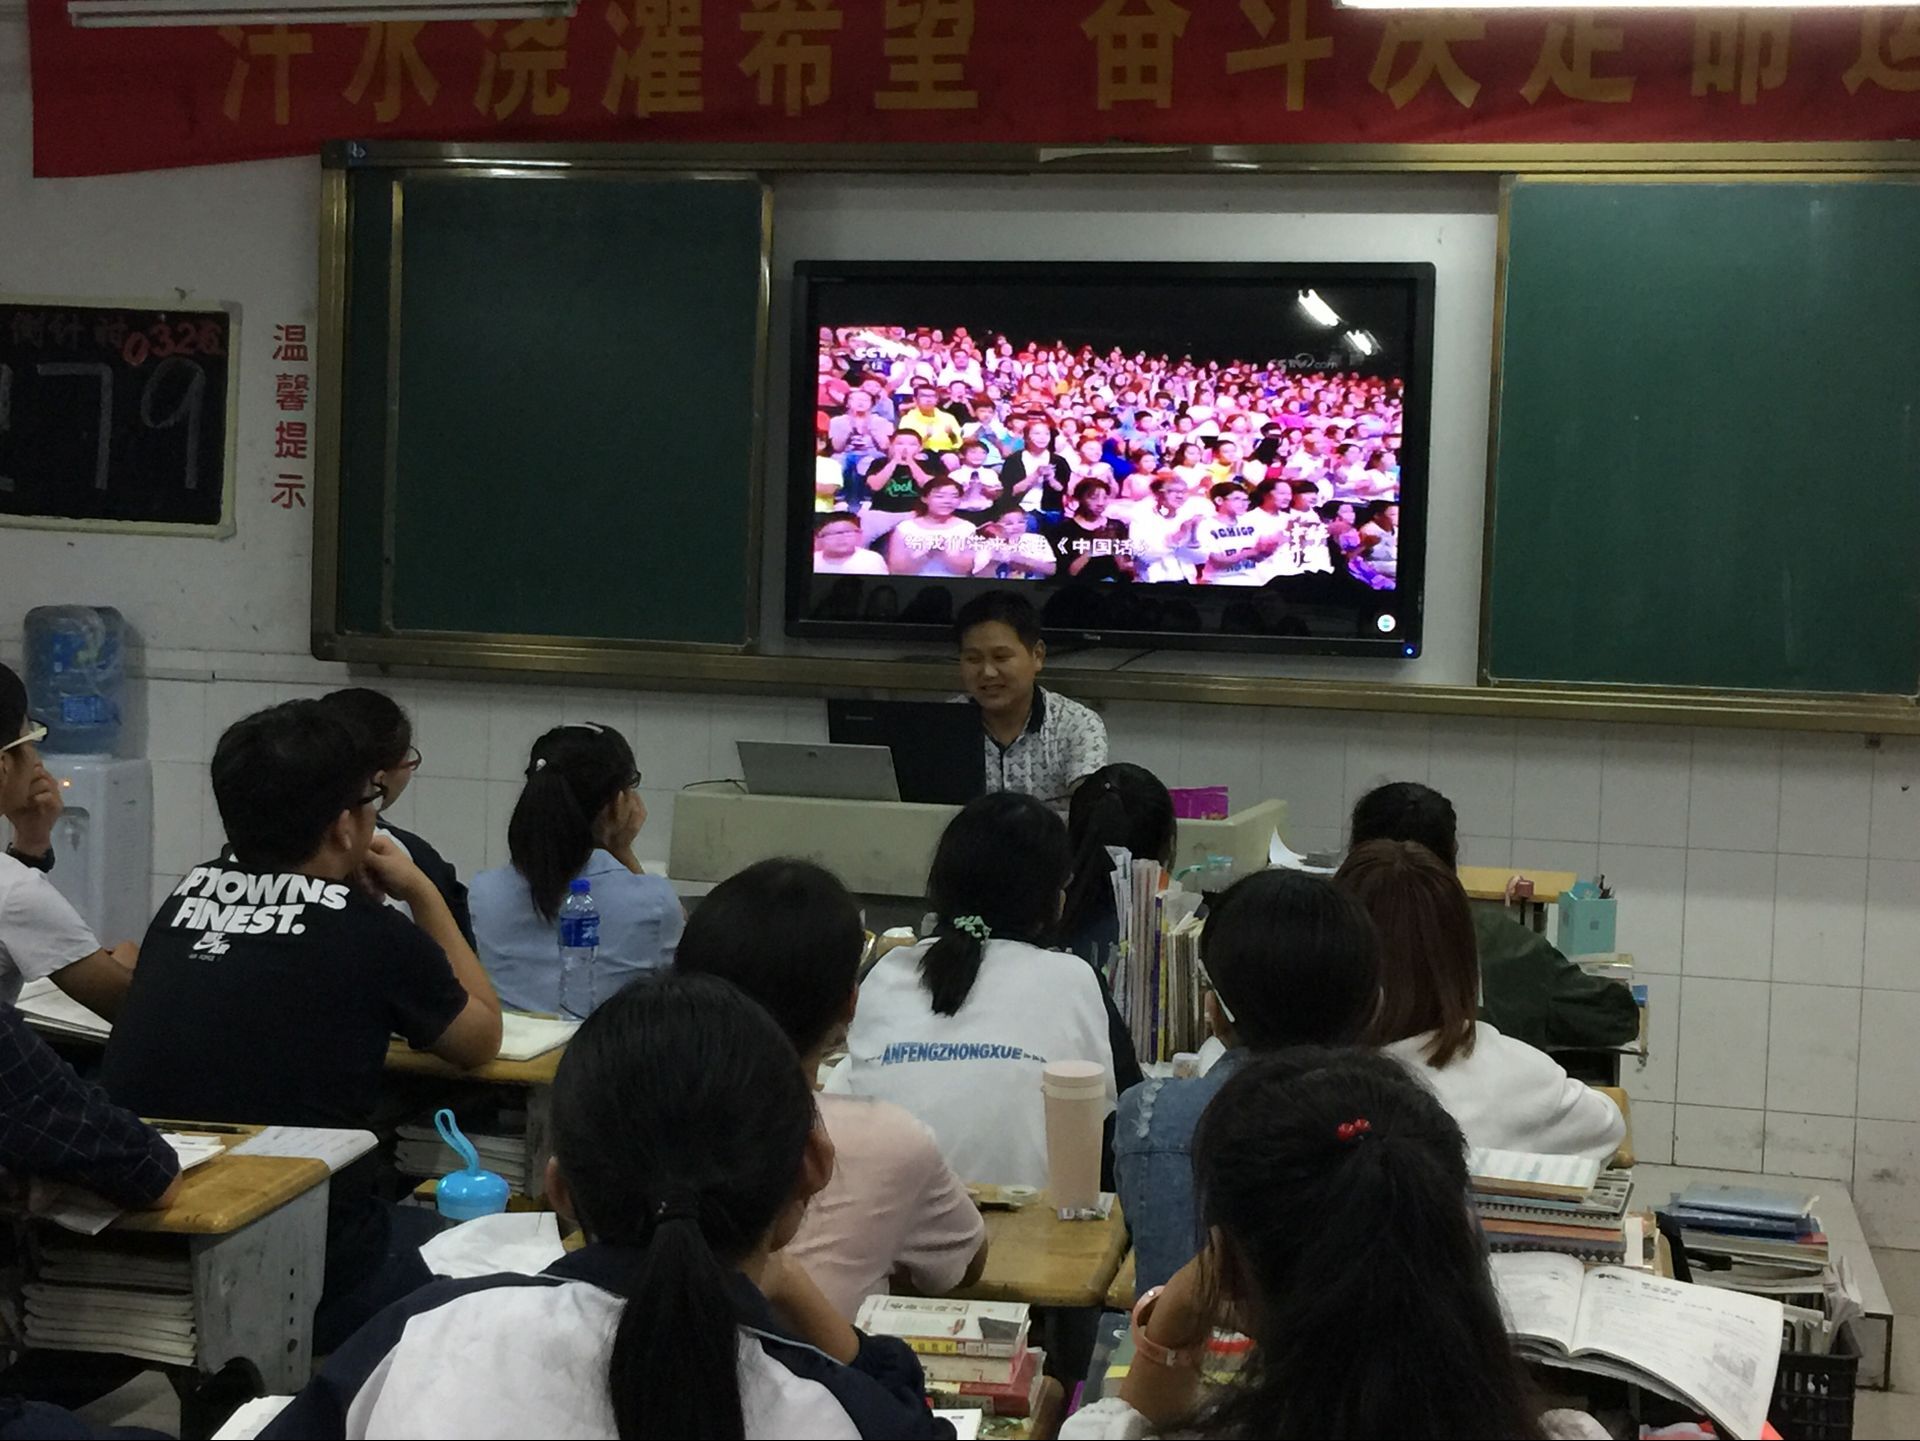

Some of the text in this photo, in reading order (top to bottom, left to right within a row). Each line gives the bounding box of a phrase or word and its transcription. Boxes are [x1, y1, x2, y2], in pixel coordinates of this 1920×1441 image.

[217, 0, 978, 124] 汗水浇灌希望
[0, 357, 207, 491] 79
[271, 324, 310, 509] 温馨提示
[170, 897, 306, 935] FINEST.
[881, 1042, 1023, 1066] ANFENGZHONGXUE
